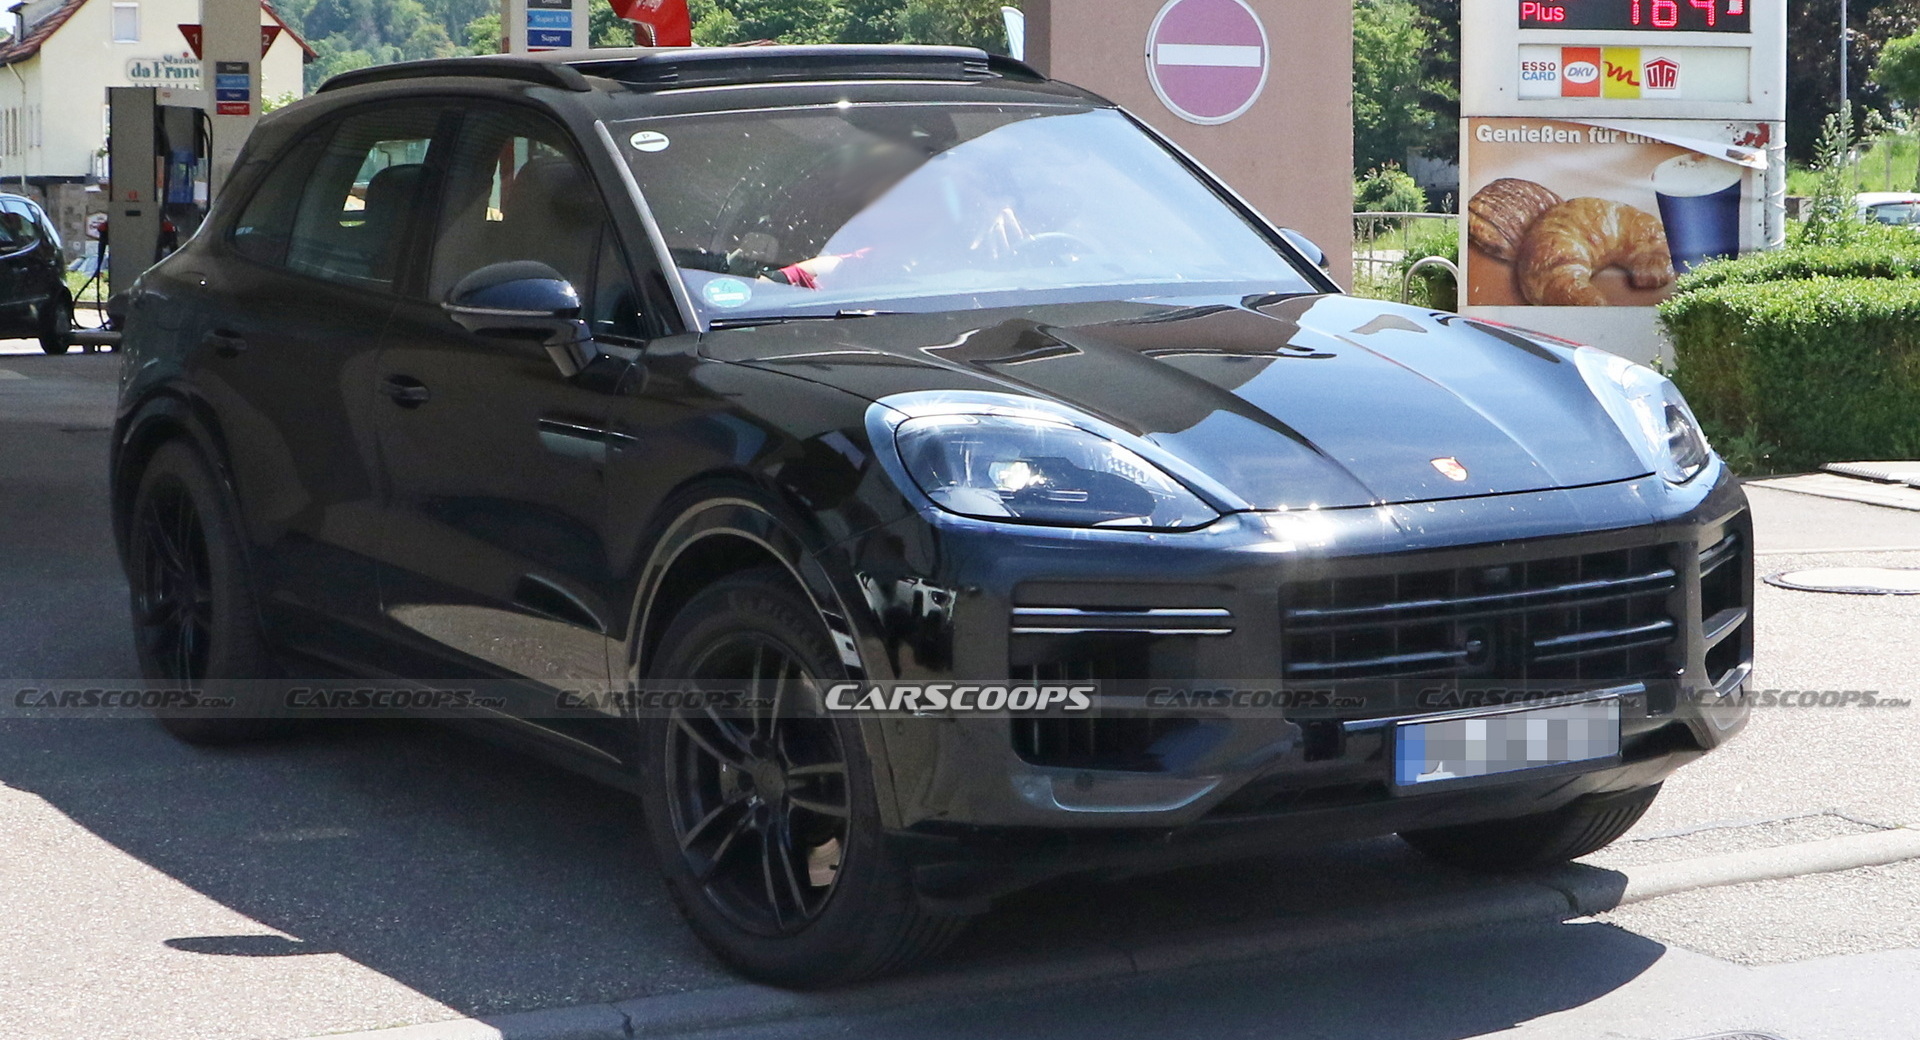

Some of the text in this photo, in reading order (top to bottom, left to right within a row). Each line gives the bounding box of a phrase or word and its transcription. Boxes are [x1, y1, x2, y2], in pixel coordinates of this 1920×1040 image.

[1522, 1, 1565, 21] Plus
[535, 15, 569, 24] Super E10
[262, 34, 270, 46] 2
[541, 34, 561, 43] Super
[131, 62, 150, 77] da
[1521, 61, 1556, 71] ESSO
[1567, 66, 1595, 77] DKV
[1521, 71, 1556, 81] CARD
[1646, 59, 1677, 88] UTA
[1475, 125, 1582, 143] Genießen
[1588, 127, 1620, 144] für
